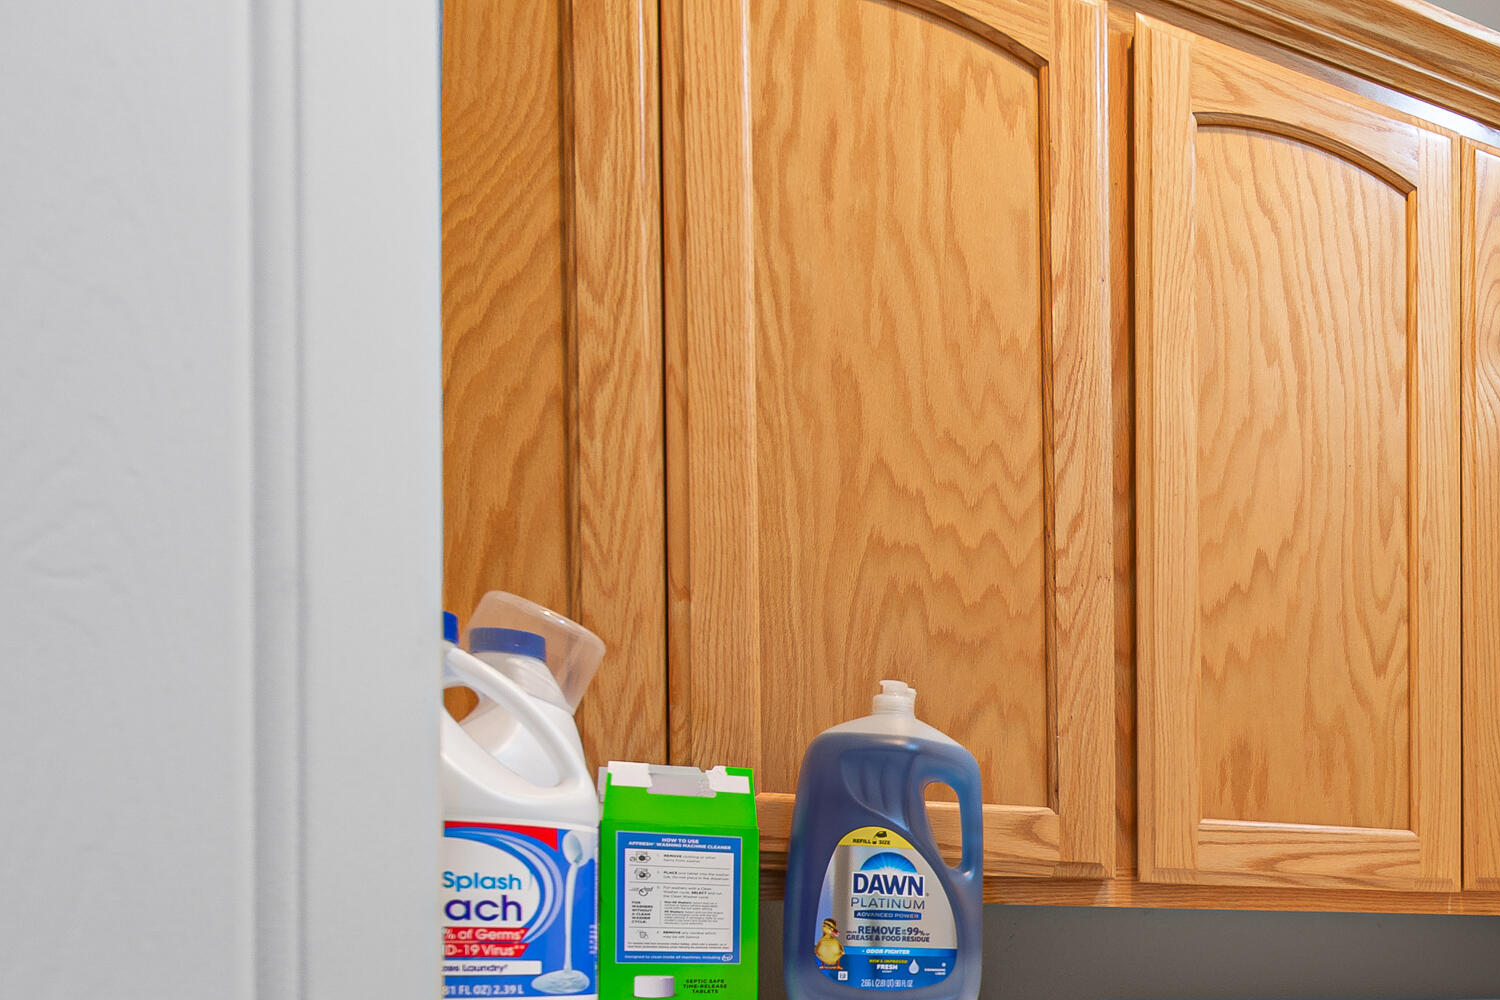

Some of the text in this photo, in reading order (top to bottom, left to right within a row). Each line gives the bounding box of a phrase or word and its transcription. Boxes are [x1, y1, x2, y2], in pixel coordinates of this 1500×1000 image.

[442, 870, 522, 893] Splash
[853, 873, 924, 897] DAWN
[444, 894, 522, 921] ach
[850, 897, 925, 909] PLATINUM
[457, 928, 473, 940] of
[857, 926, 901, 935] REMOVE
[846, 934, 874, 942] GREASE
